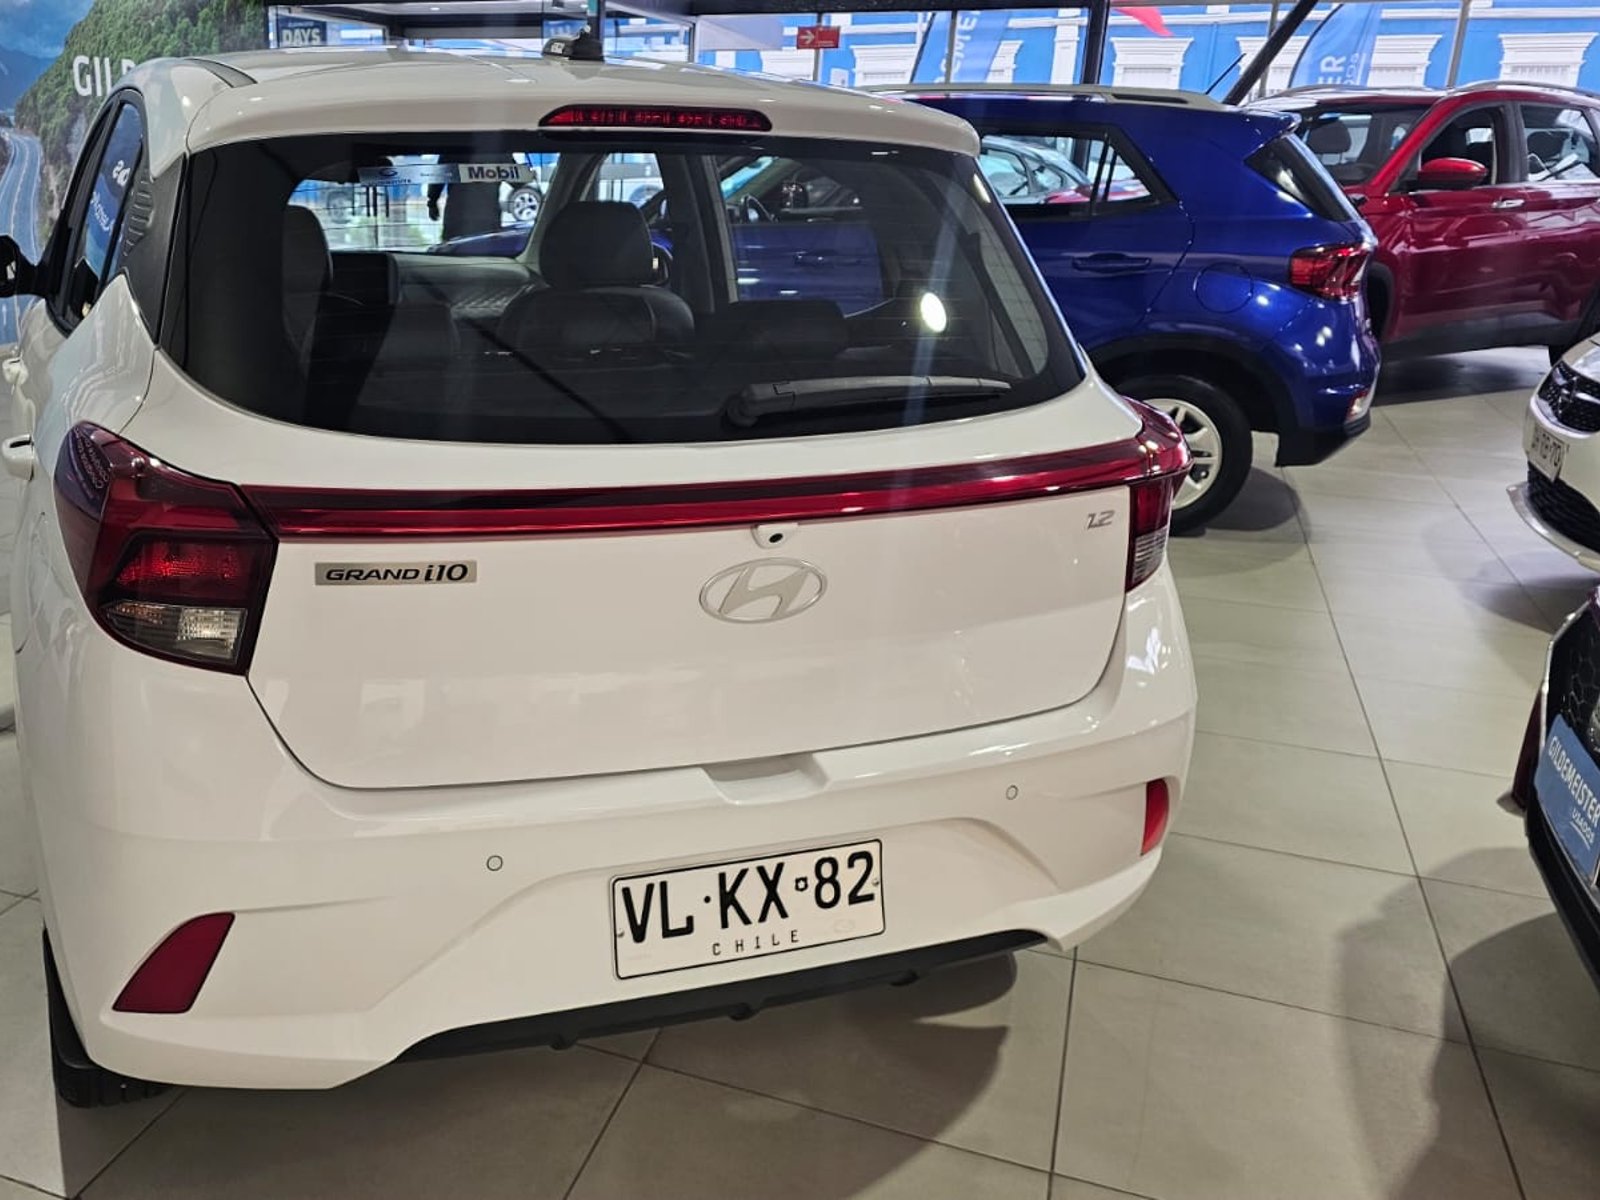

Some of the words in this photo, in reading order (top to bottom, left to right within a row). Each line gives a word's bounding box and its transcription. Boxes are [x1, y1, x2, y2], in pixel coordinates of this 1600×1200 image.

[281, 27, 321, 47] DAYS
[467, 165, 521, 181] Mobil
[325, 567, 421, 582] GRAND
[424, 563, 469, 582] i10
[1548, 735, 1600, 828] GILDEMEISTER
[1572, 806, 1595, 844] USADOS
[711, 929, 800, 957] CHILE
